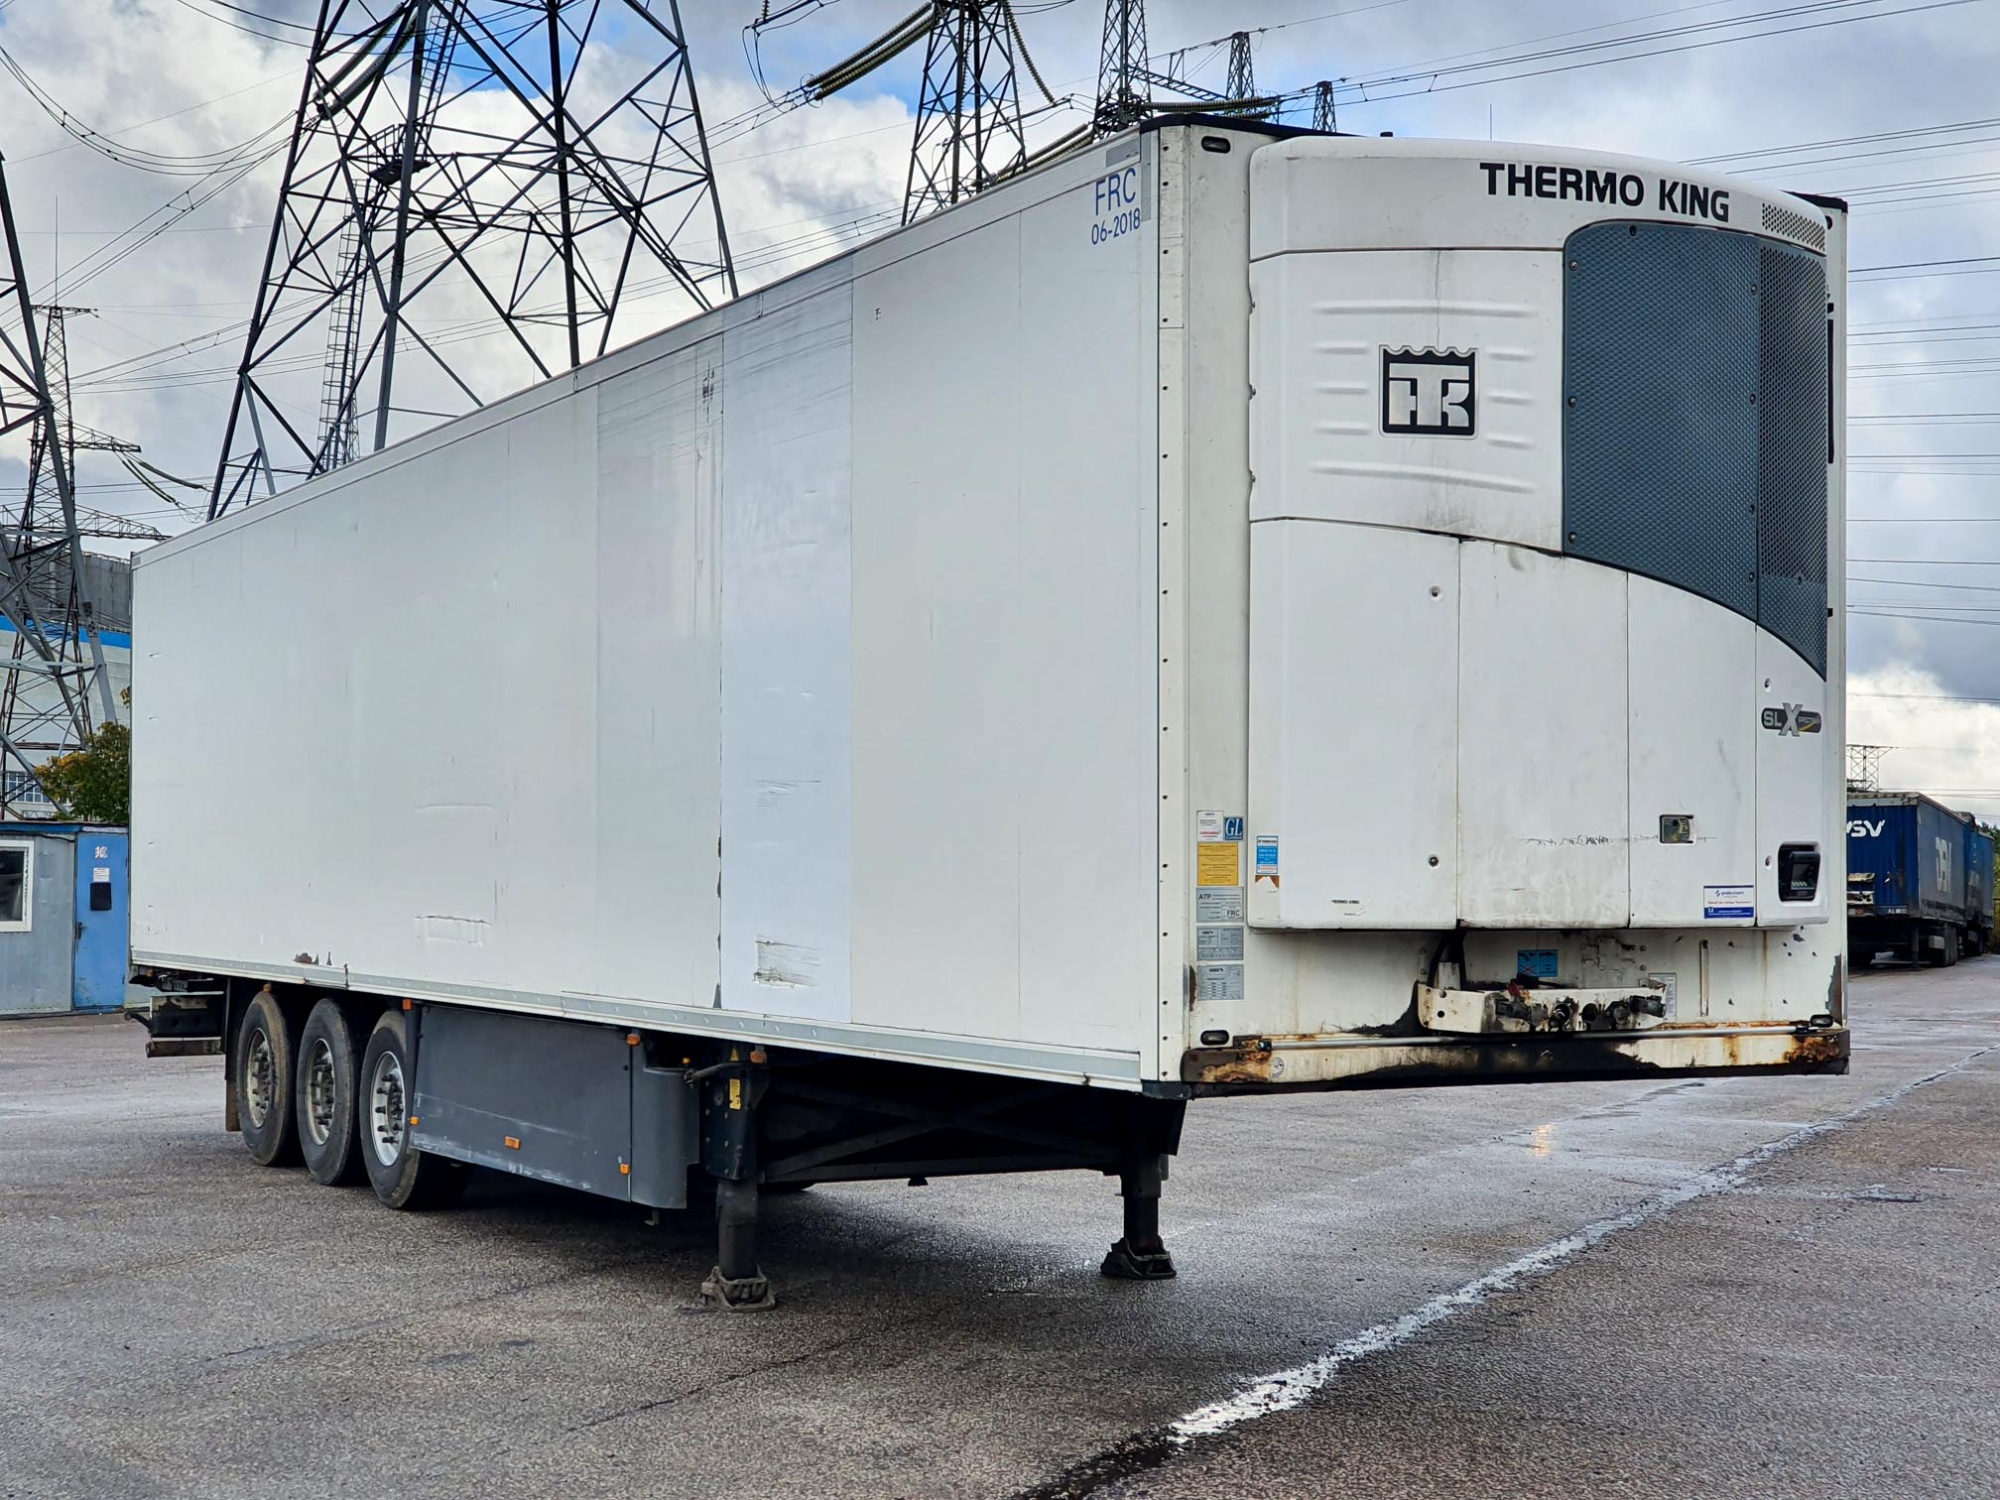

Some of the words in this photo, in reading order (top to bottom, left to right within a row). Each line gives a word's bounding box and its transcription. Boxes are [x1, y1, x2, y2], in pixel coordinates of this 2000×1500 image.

[1095, 167, 1136, 216] FRC
[1480, 162, 1644, 206] THERMO
[1659, 178, 1730, 223] KING
[1091, 207, 1141, 246] 06-2018
[1225, 817, 1243, 836] GL
[1226, 909, 1240, 917] FRC
